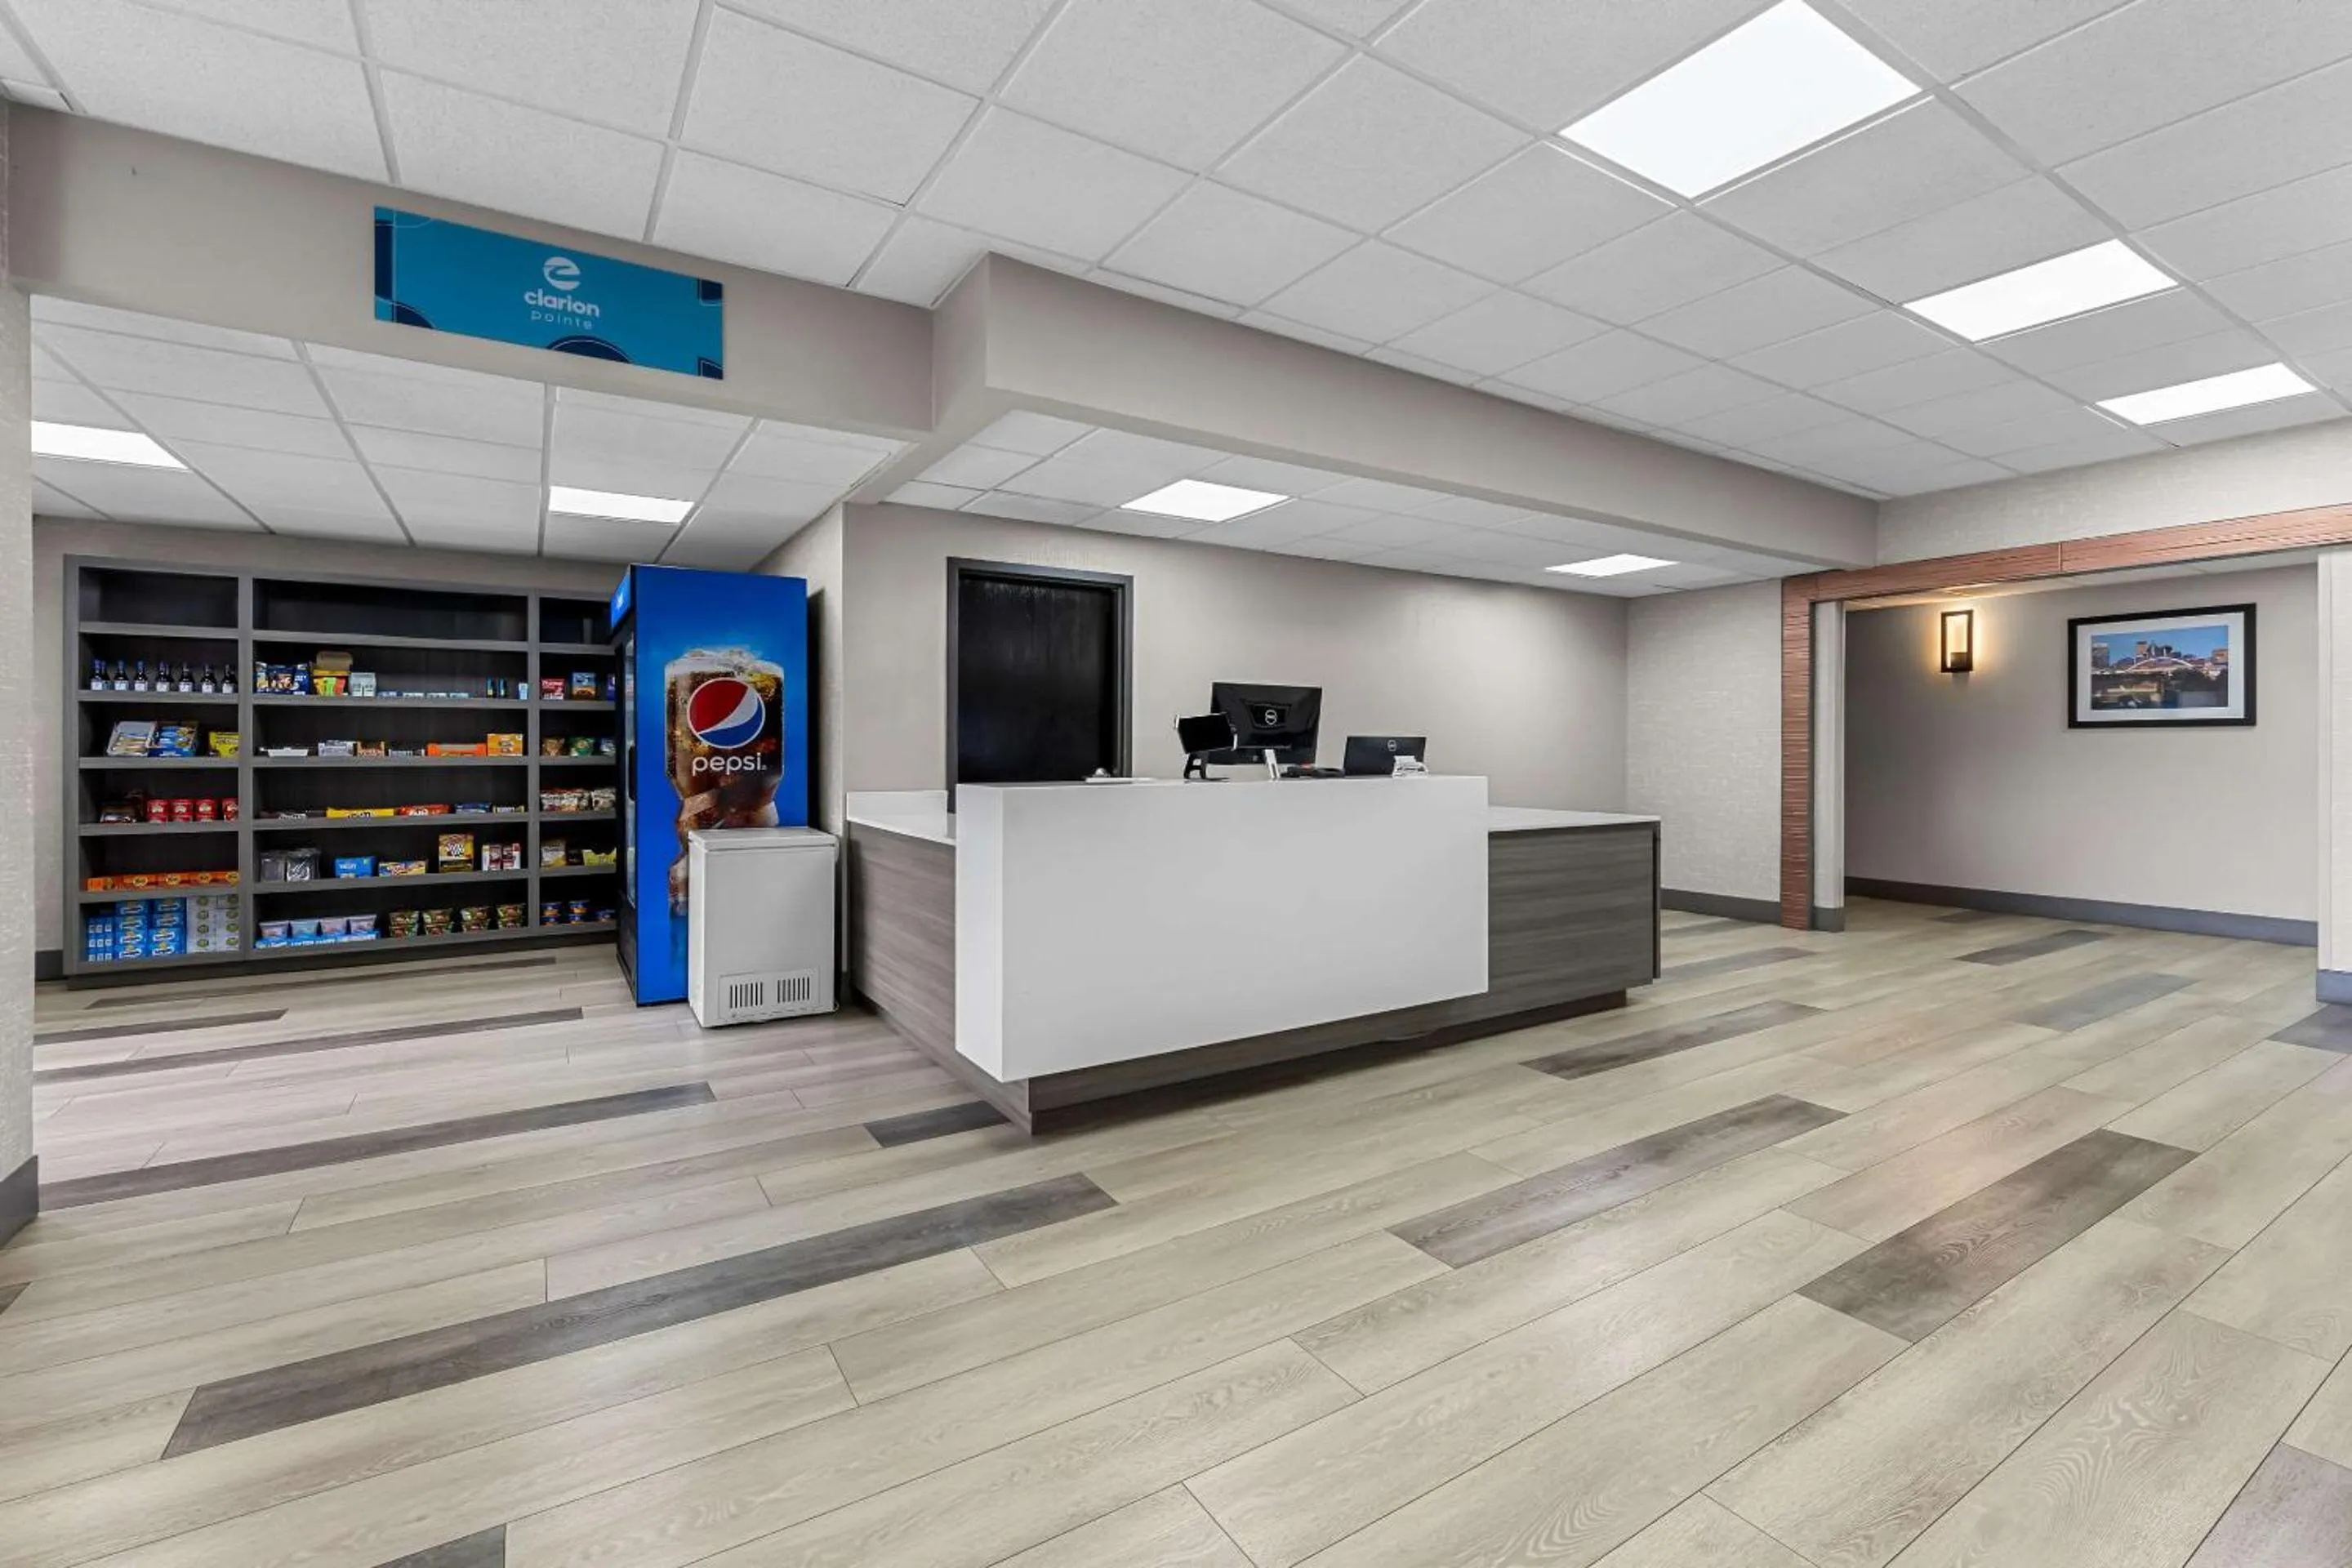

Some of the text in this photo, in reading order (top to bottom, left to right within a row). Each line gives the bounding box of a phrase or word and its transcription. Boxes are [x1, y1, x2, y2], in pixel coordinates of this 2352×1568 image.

[523, 288, 600, 318] clarion
[531, 310, 592, 330] pointe
[692, 752, 761, 777] pepsi
